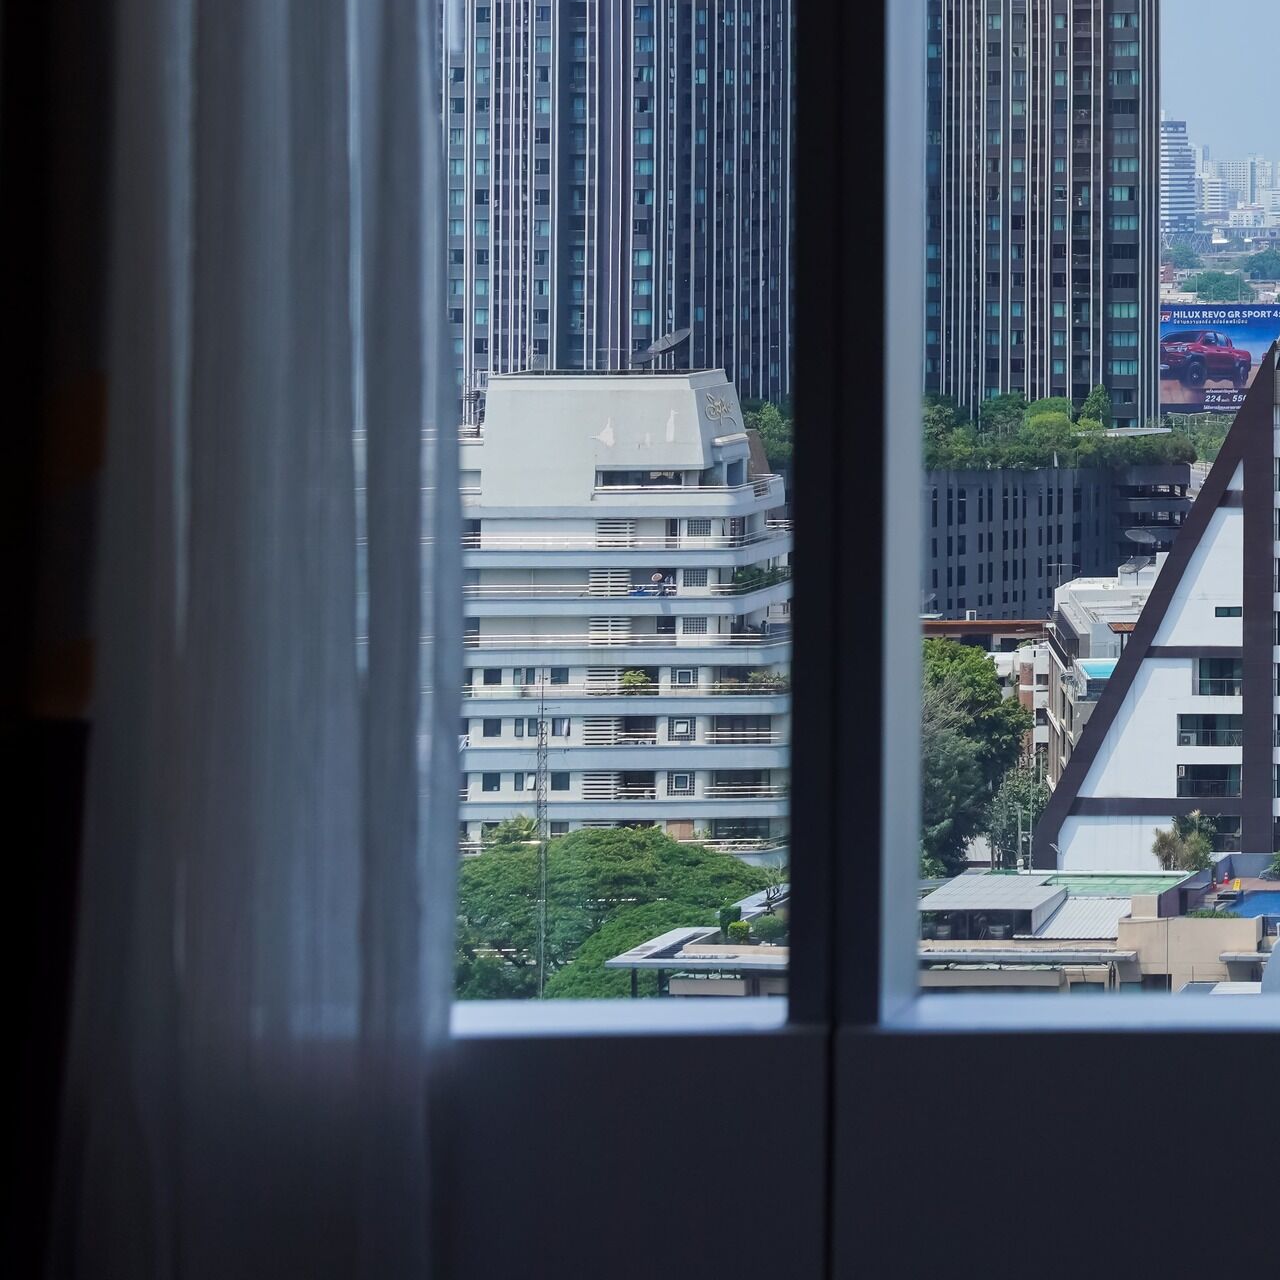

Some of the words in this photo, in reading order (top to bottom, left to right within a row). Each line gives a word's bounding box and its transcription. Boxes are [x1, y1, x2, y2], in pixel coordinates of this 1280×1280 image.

[1173, 311, 1201, 319] HILUX
[1202, 311, 1226, 319] REVO
[1227, 310, 1241, 318] GR
[1242, 310, 1272, 318] SPORT
[1205, 394, 1221, 402] 224
